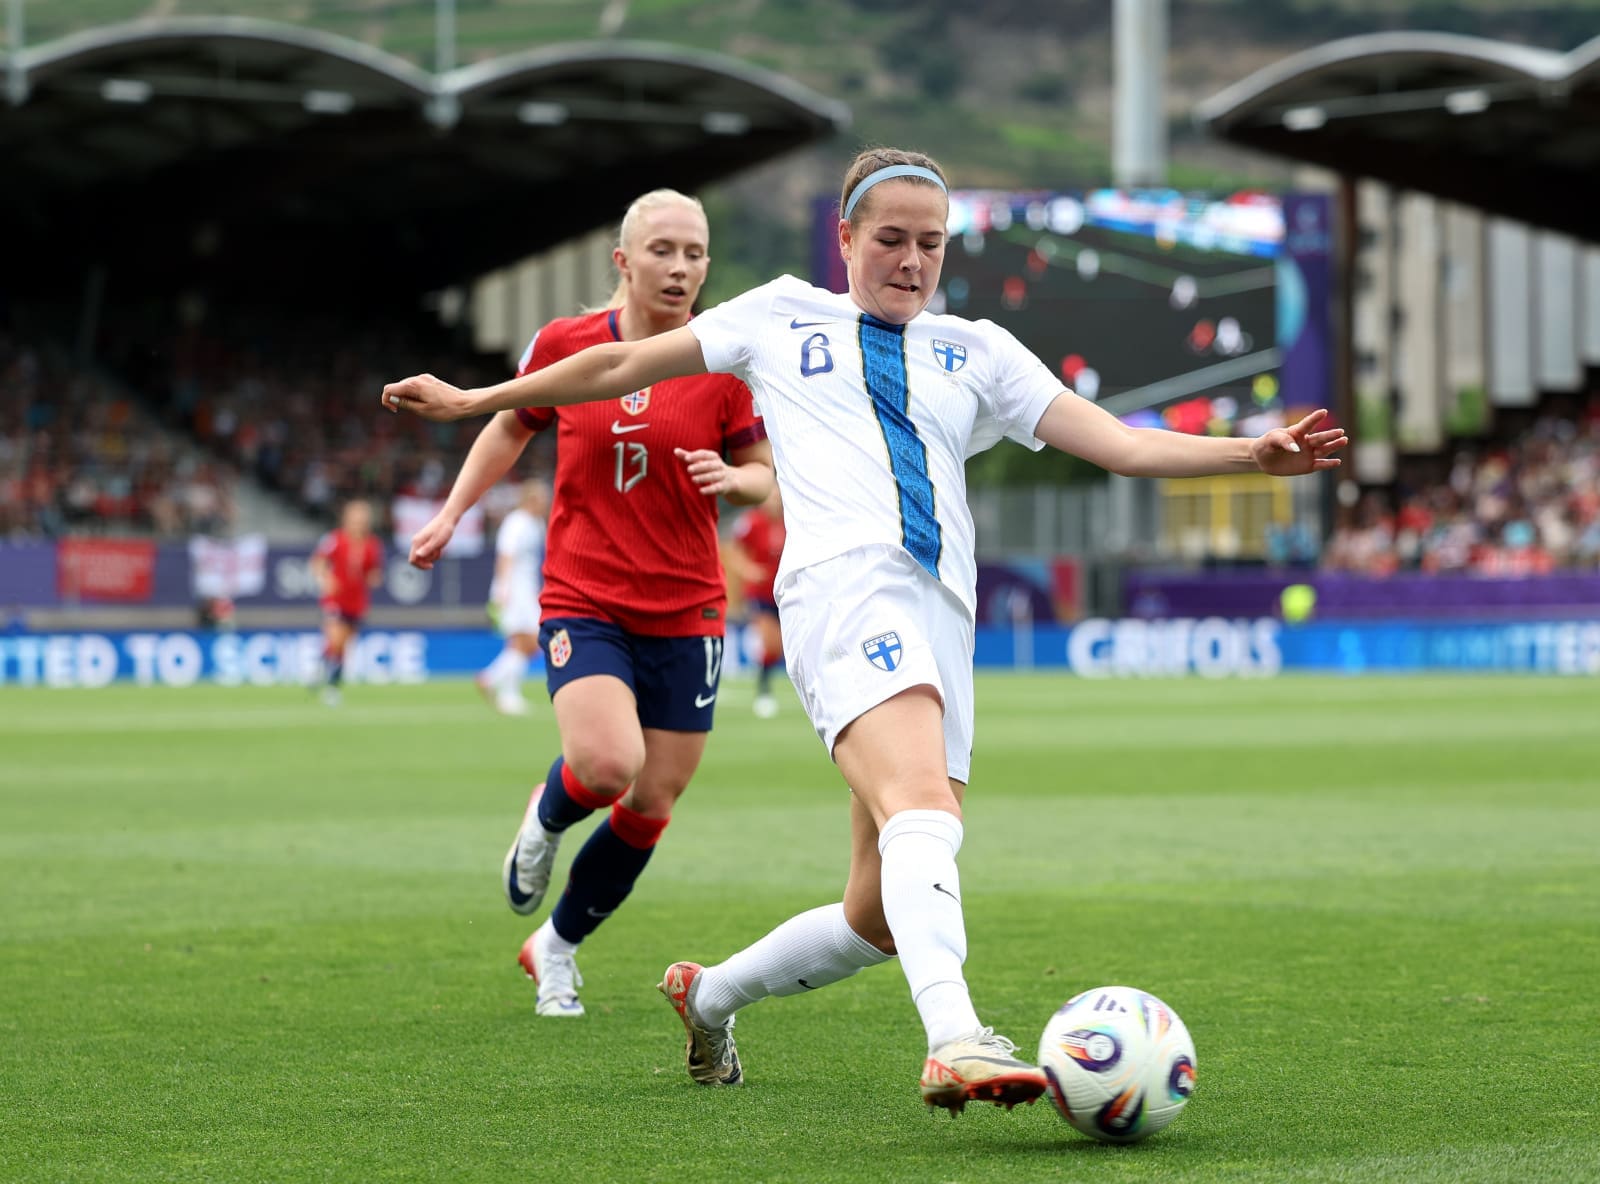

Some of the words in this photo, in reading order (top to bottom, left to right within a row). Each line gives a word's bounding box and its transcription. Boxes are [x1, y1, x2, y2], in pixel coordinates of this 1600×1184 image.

[800, 332, 834, 378] 6
[613, 441, 648, 493] 13
[123, 633, 203, 689] TO
